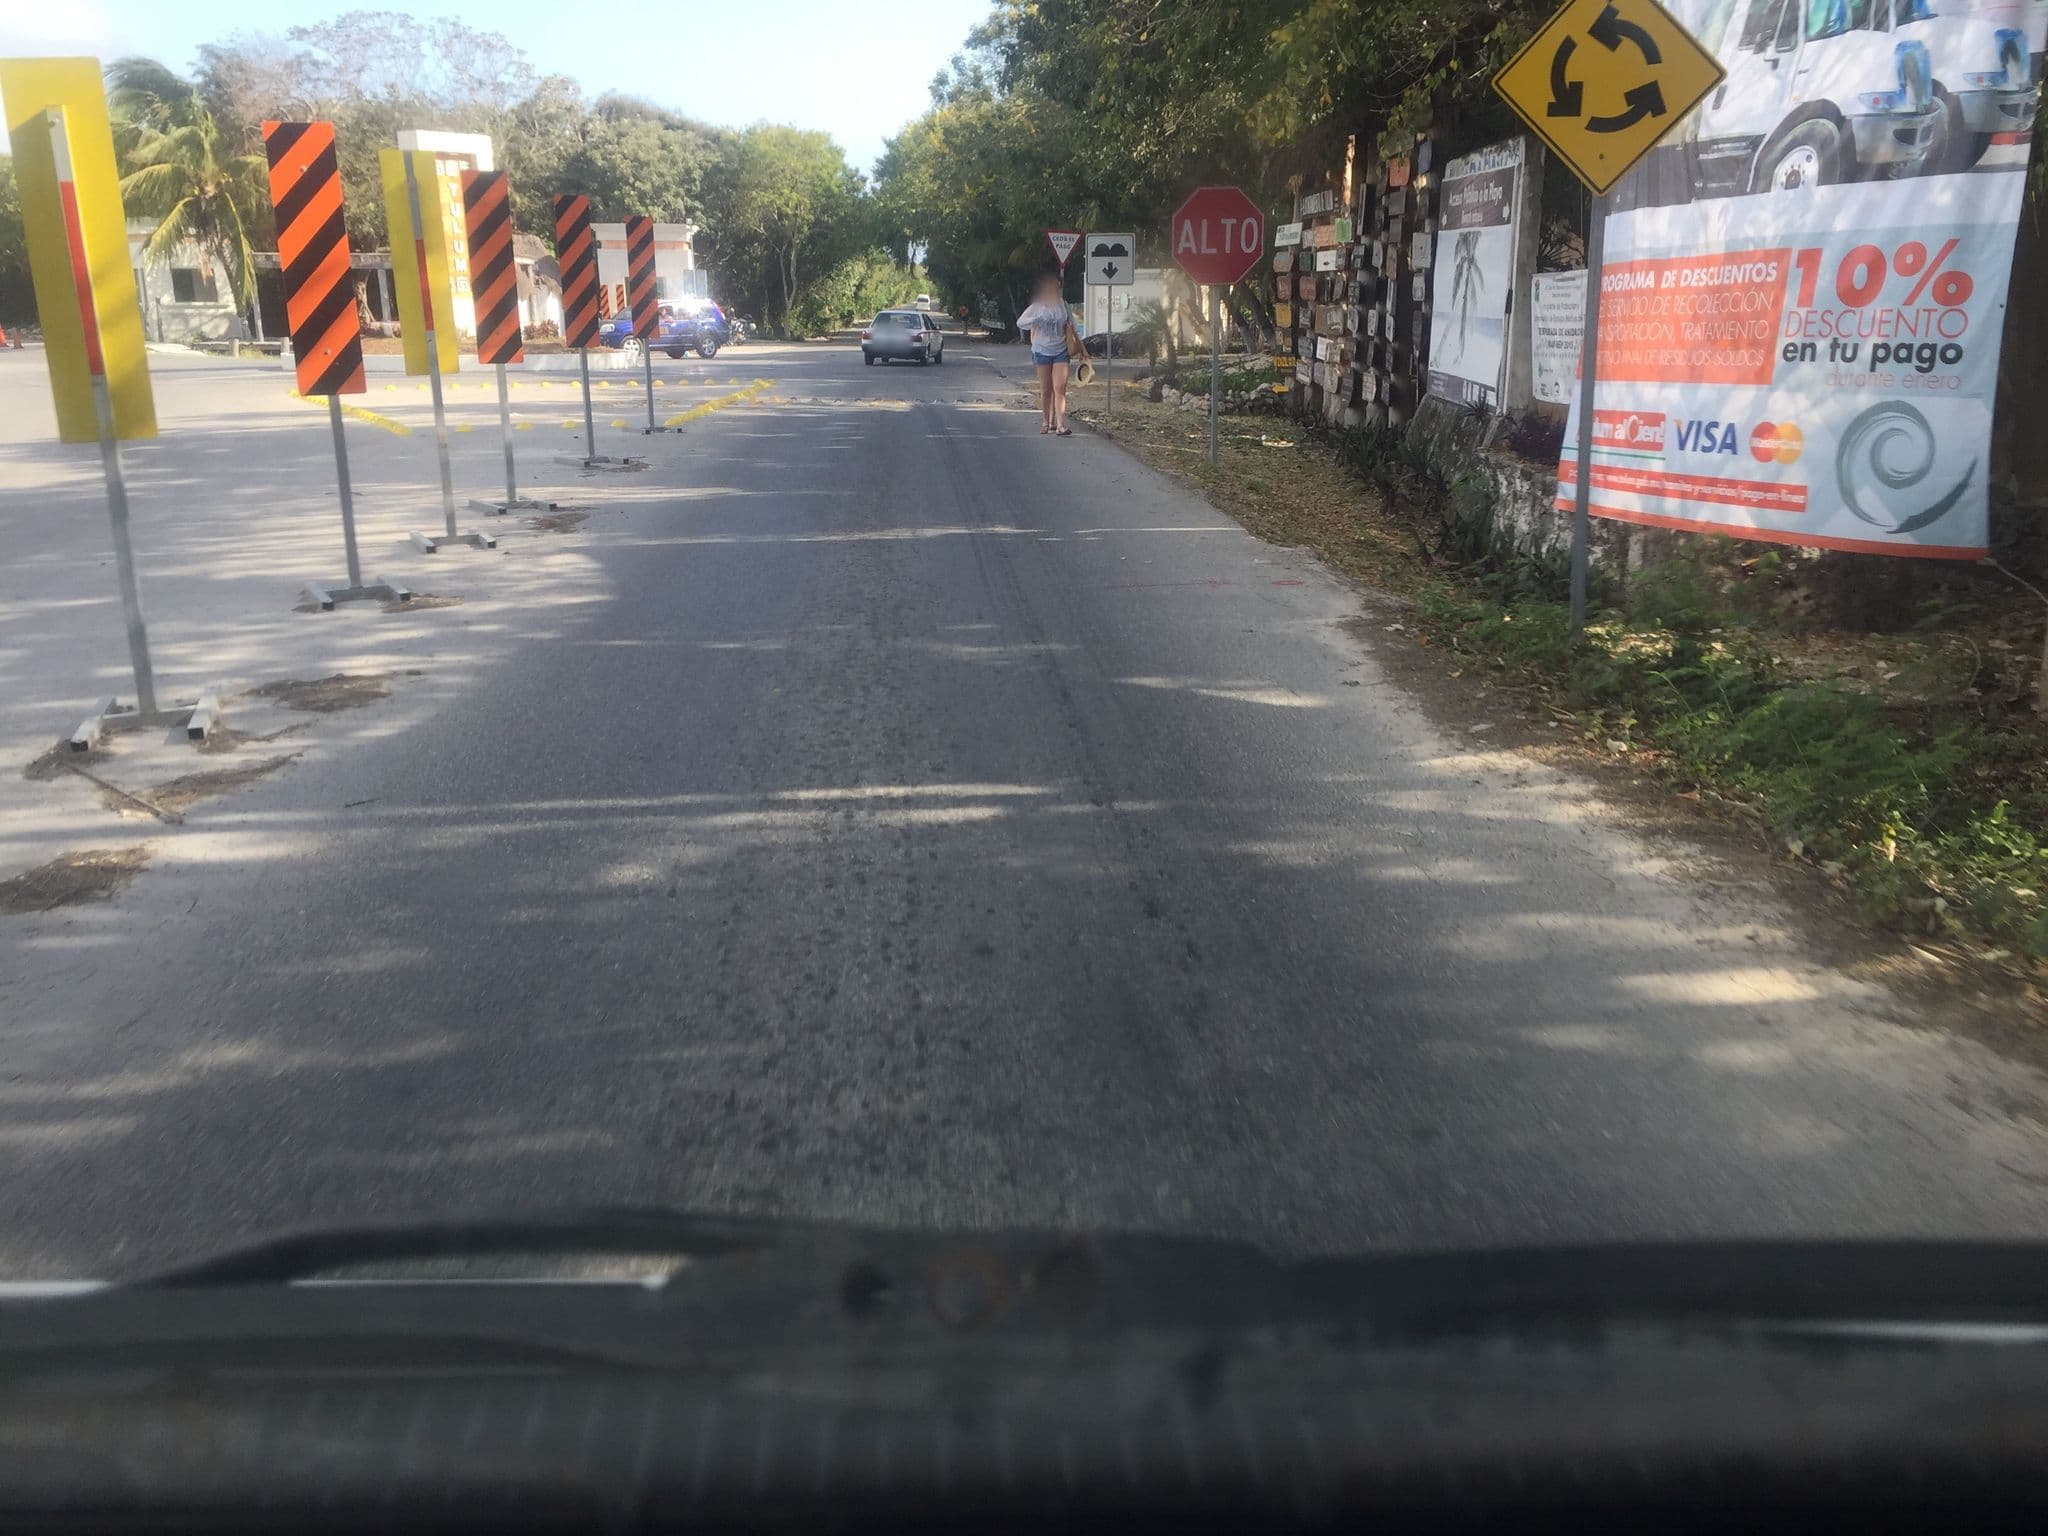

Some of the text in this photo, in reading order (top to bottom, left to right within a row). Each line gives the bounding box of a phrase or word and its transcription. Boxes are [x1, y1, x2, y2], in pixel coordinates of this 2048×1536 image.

[1178, 217, 1259, 254] ALTO
[1661, 269, 1678, 288] DE
[1680, 261, 1778, 287] DESCUENTOS
[1796, 238, 1973, 308] 10%
[1673, 286, 1774, 315] RECOLECCIÓN
[1681, 319, 1770, 341] TRATAMIENTO
[1784, 307, 1969, 339] DESCUENTO
[1782, 337, 1963, 373] en tu pago
[1903, 375, 1962, 390] enero
[1674, 418, 1738, 455] VISA
